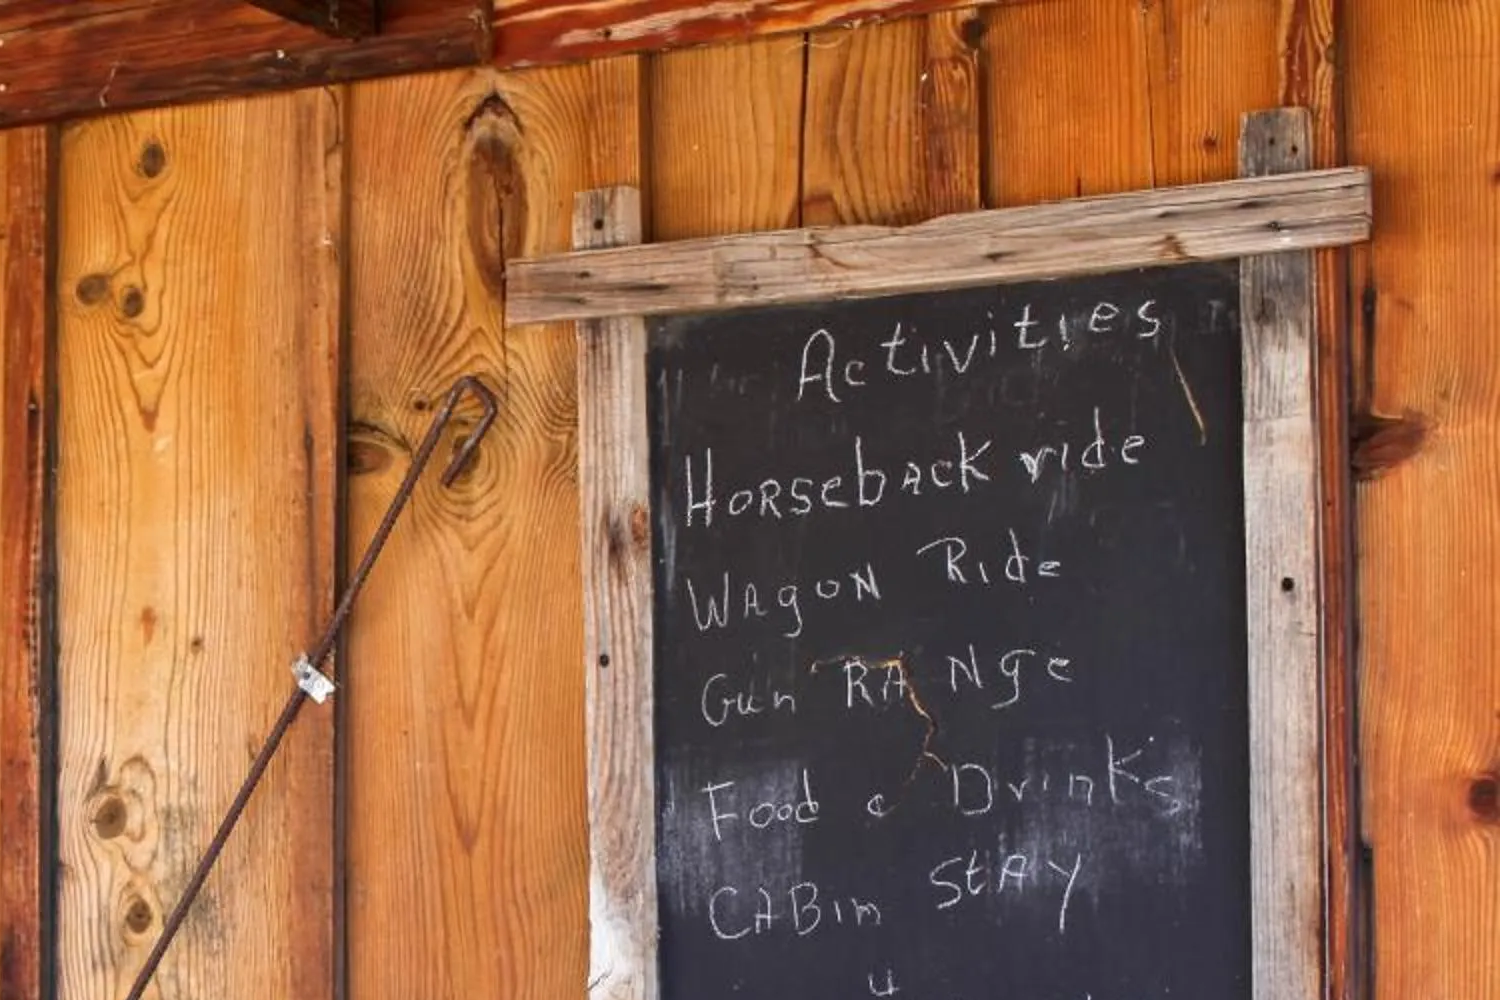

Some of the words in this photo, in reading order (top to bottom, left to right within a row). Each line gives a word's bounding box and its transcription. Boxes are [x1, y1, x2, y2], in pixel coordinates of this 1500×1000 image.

[797, 299, 1161, 402] Activities
[1019, 407, 1145, 483] ride
[915, 528, 1062, 585] Ride
[701, 672, 796, 726] Gun
[700, 769, 819, 840] Food
